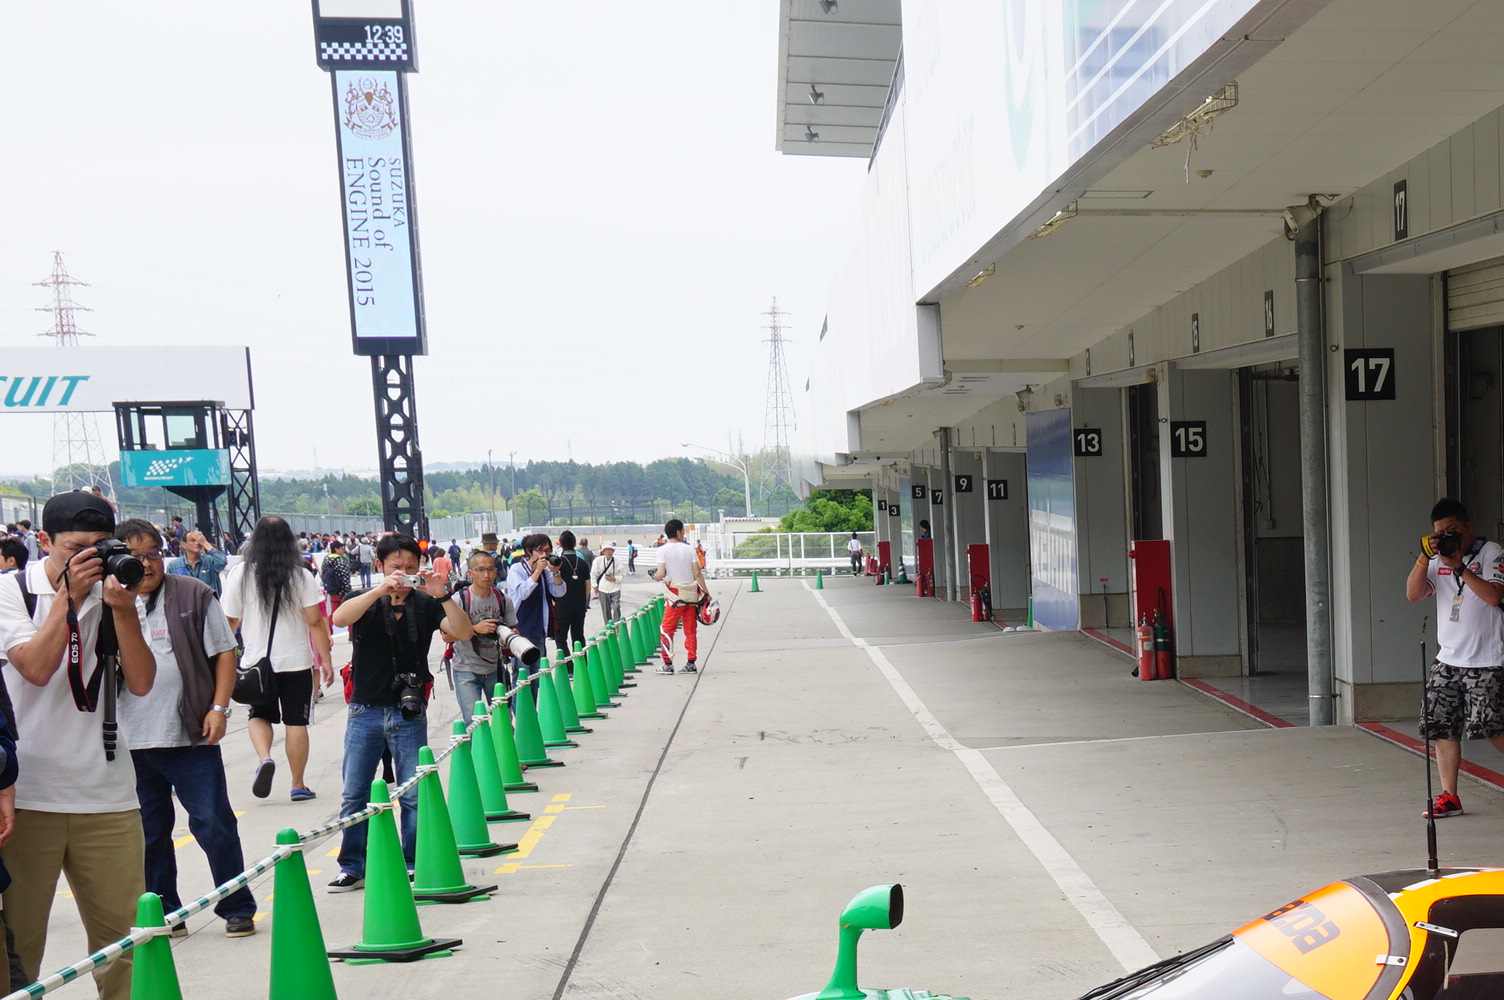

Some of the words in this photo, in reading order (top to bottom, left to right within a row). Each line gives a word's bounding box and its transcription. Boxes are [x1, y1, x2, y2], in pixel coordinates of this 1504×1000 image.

[368, 157, 391, 220] Sound
[389, 158, 405, 228] SUZUKA
[346, 157, 370, 249] ENGINE
[1394, 190, 1405, 232] 17
[373, 230, 394, 251] of
[354, 258, 375, 306] 2015
[1351, 357, 1391, 393] 17
[0, 376, 90, 407] UIT
[1077, 433, 1099, 453] 13
[1175, 427, 1204, 452] 15
[915, 487, 922, 497] 5
[960, 478, 967, 490] 9
[989, 483, 1005, 498] 11
[935, 491, 943, 503] 7
[71, 644, 79, 664] EOS
